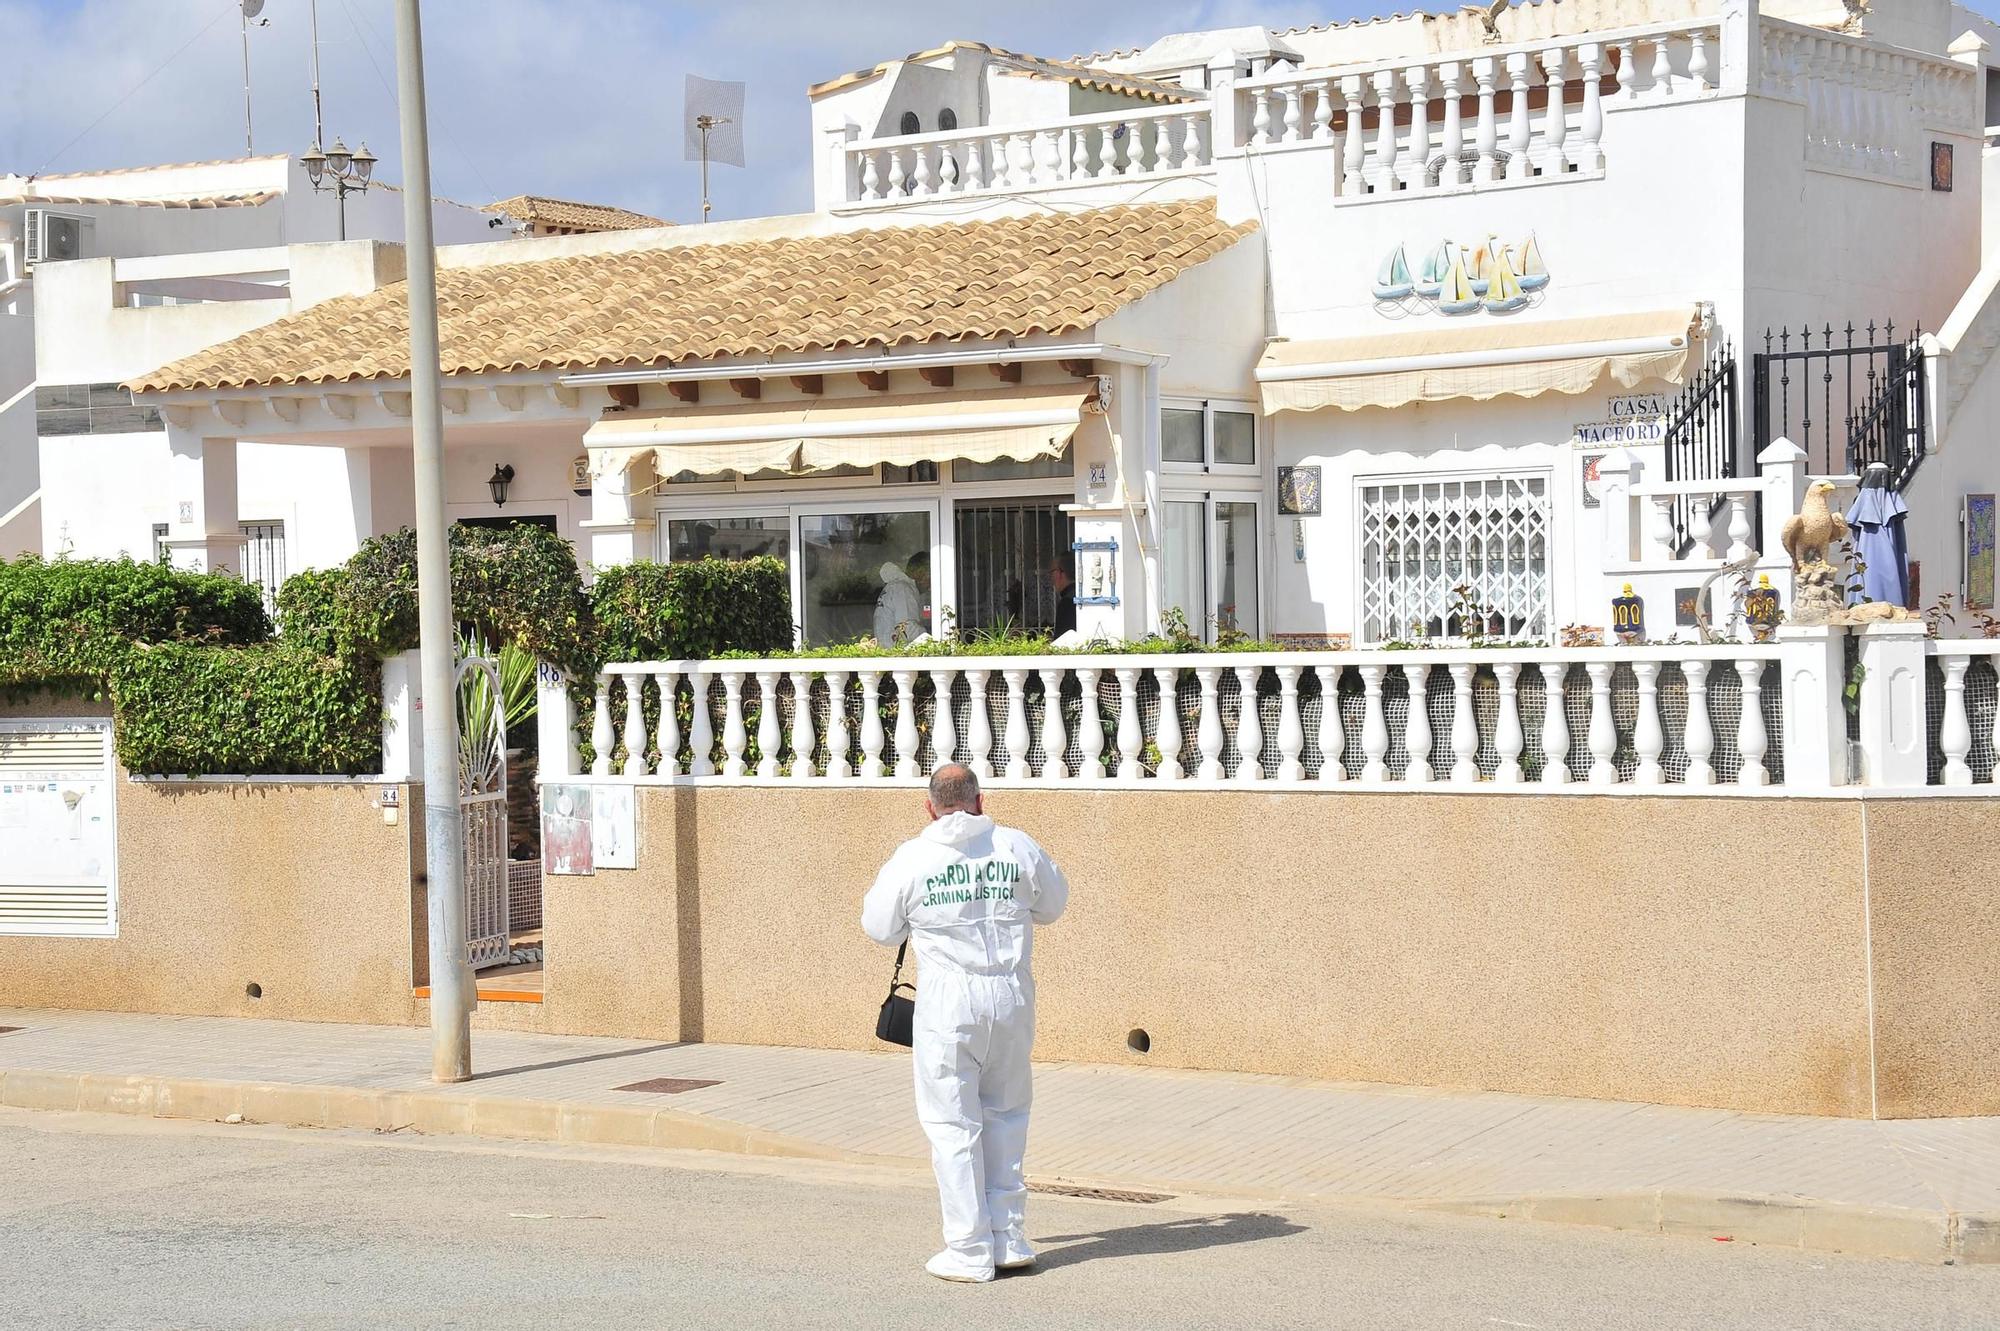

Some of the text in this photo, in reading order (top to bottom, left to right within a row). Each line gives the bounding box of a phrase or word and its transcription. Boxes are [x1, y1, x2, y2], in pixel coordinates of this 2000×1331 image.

[1613, 399, 1659, 416] CASA
[1091, 468, 1105, 482] 84
[383, 790, 396, 801] 84
[986, 860, 1021, 883] CIVIL
